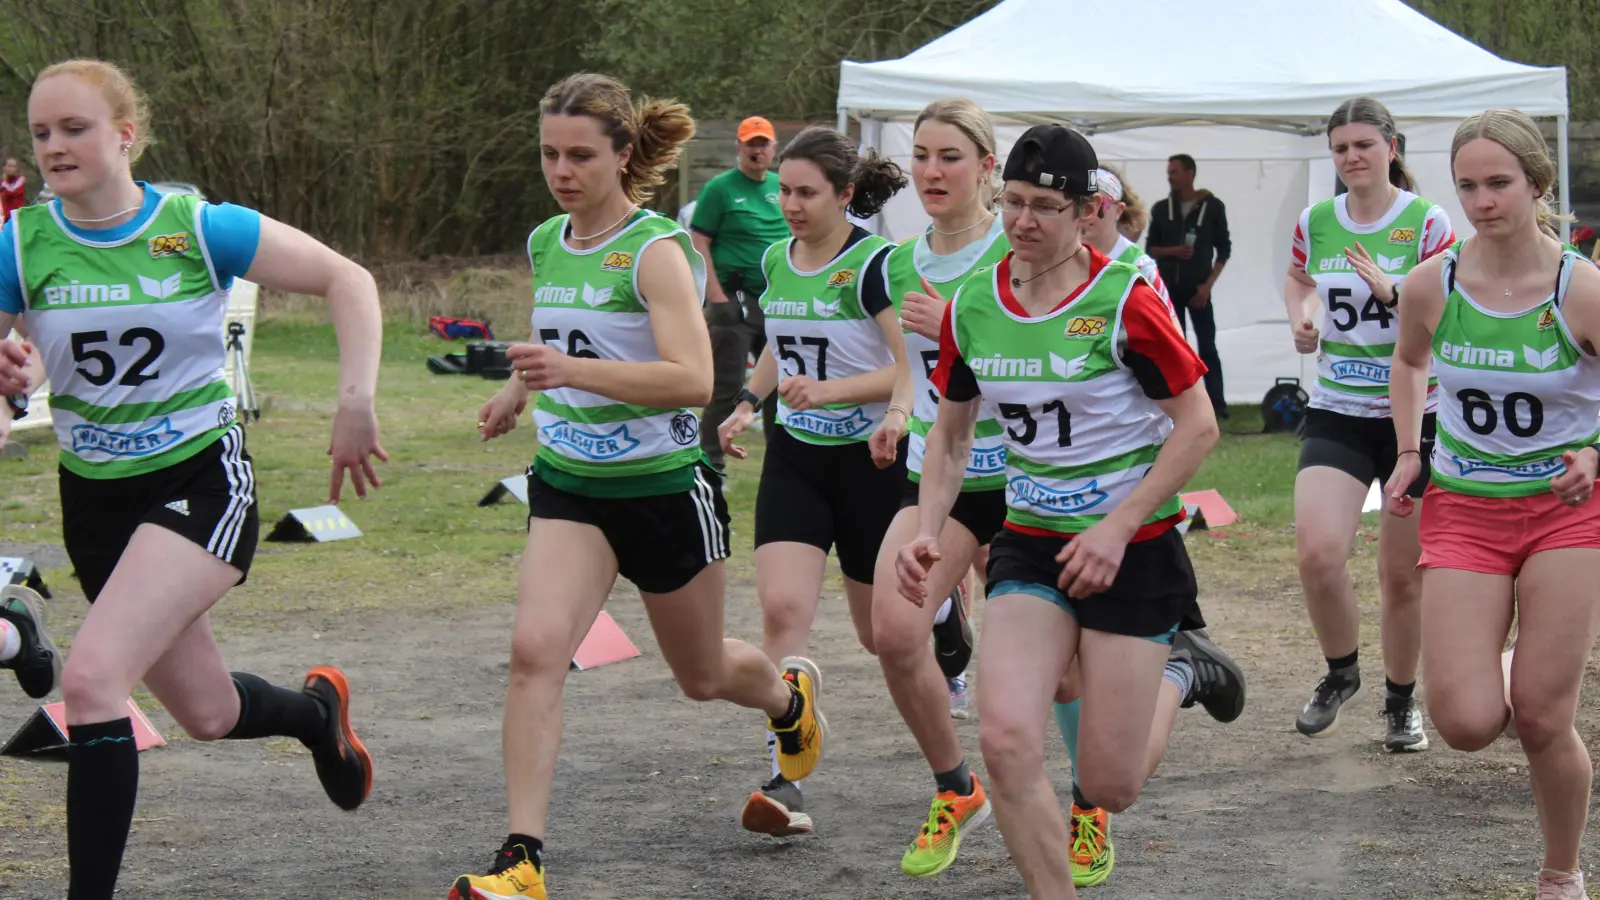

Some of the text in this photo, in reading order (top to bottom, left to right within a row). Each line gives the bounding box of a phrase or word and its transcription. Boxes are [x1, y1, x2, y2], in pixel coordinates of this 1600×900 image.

[44, 280, 130, 304] erima
[1328, 288, 1394, 332] 54
[71, 327, 165, 387] 52
[776, 336, 829, 381] 57
[969, 353, 1042, 377] erima
[1440, 341, 1515, 368] erima
[1338, 363, 1391, 380] WALTHE
[792, 417, 857, 435] WALTHER
[998, 399, 1072, 447] 51
[1456, 388, 1544, 438] 60
[80, 429, 161, 451] WALTHER
[1016, 481, 1086, 508] WALTHER
